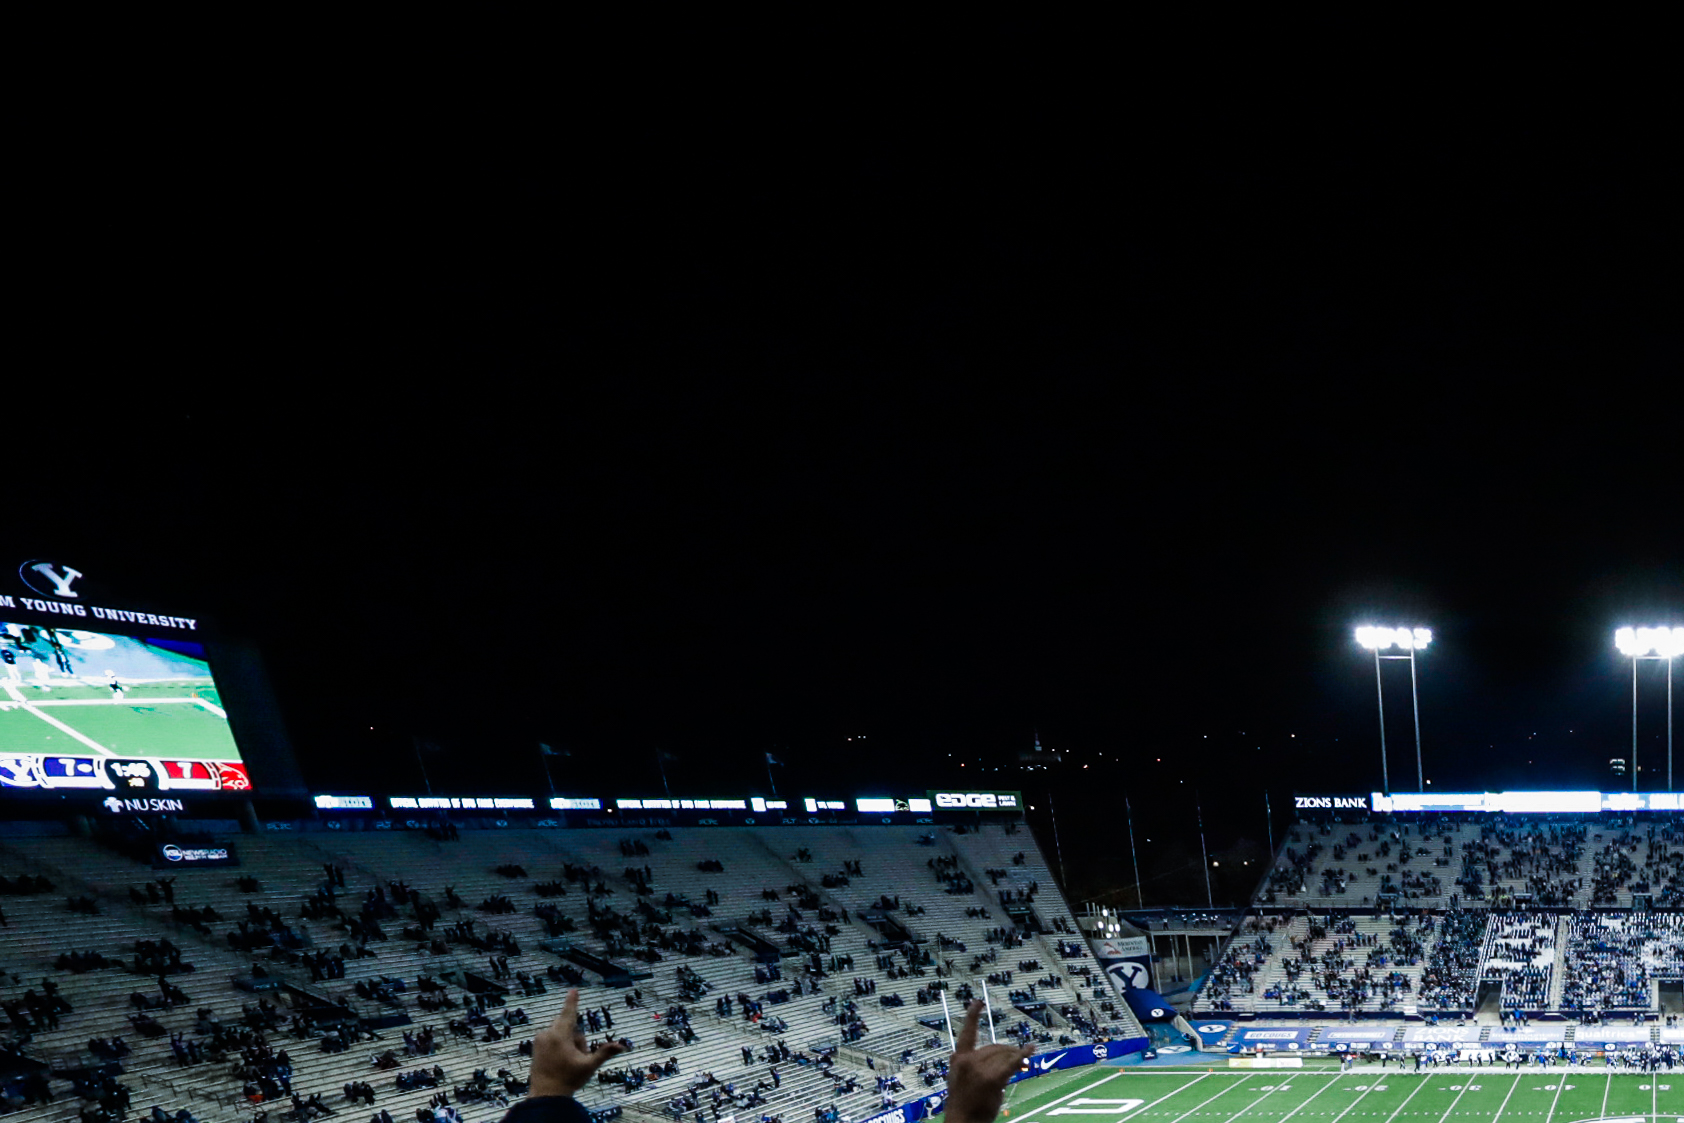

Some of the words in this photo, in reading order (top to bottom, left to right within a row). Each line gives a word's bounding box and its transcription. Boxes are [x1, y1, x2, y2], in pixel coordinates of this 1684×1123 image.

[20, 597, 87, 617] YOUNG
[91, 606, 196, 630] UNIVERSITY
[125, 798, 149, 811] NU
[149, 798, 184, 811] SKIN
[1295, 797, 1332, 808] ZIONS
[1334, 797, 1367, 808] BANK
[1576, 1030, 1634, 1040] qualtrics
